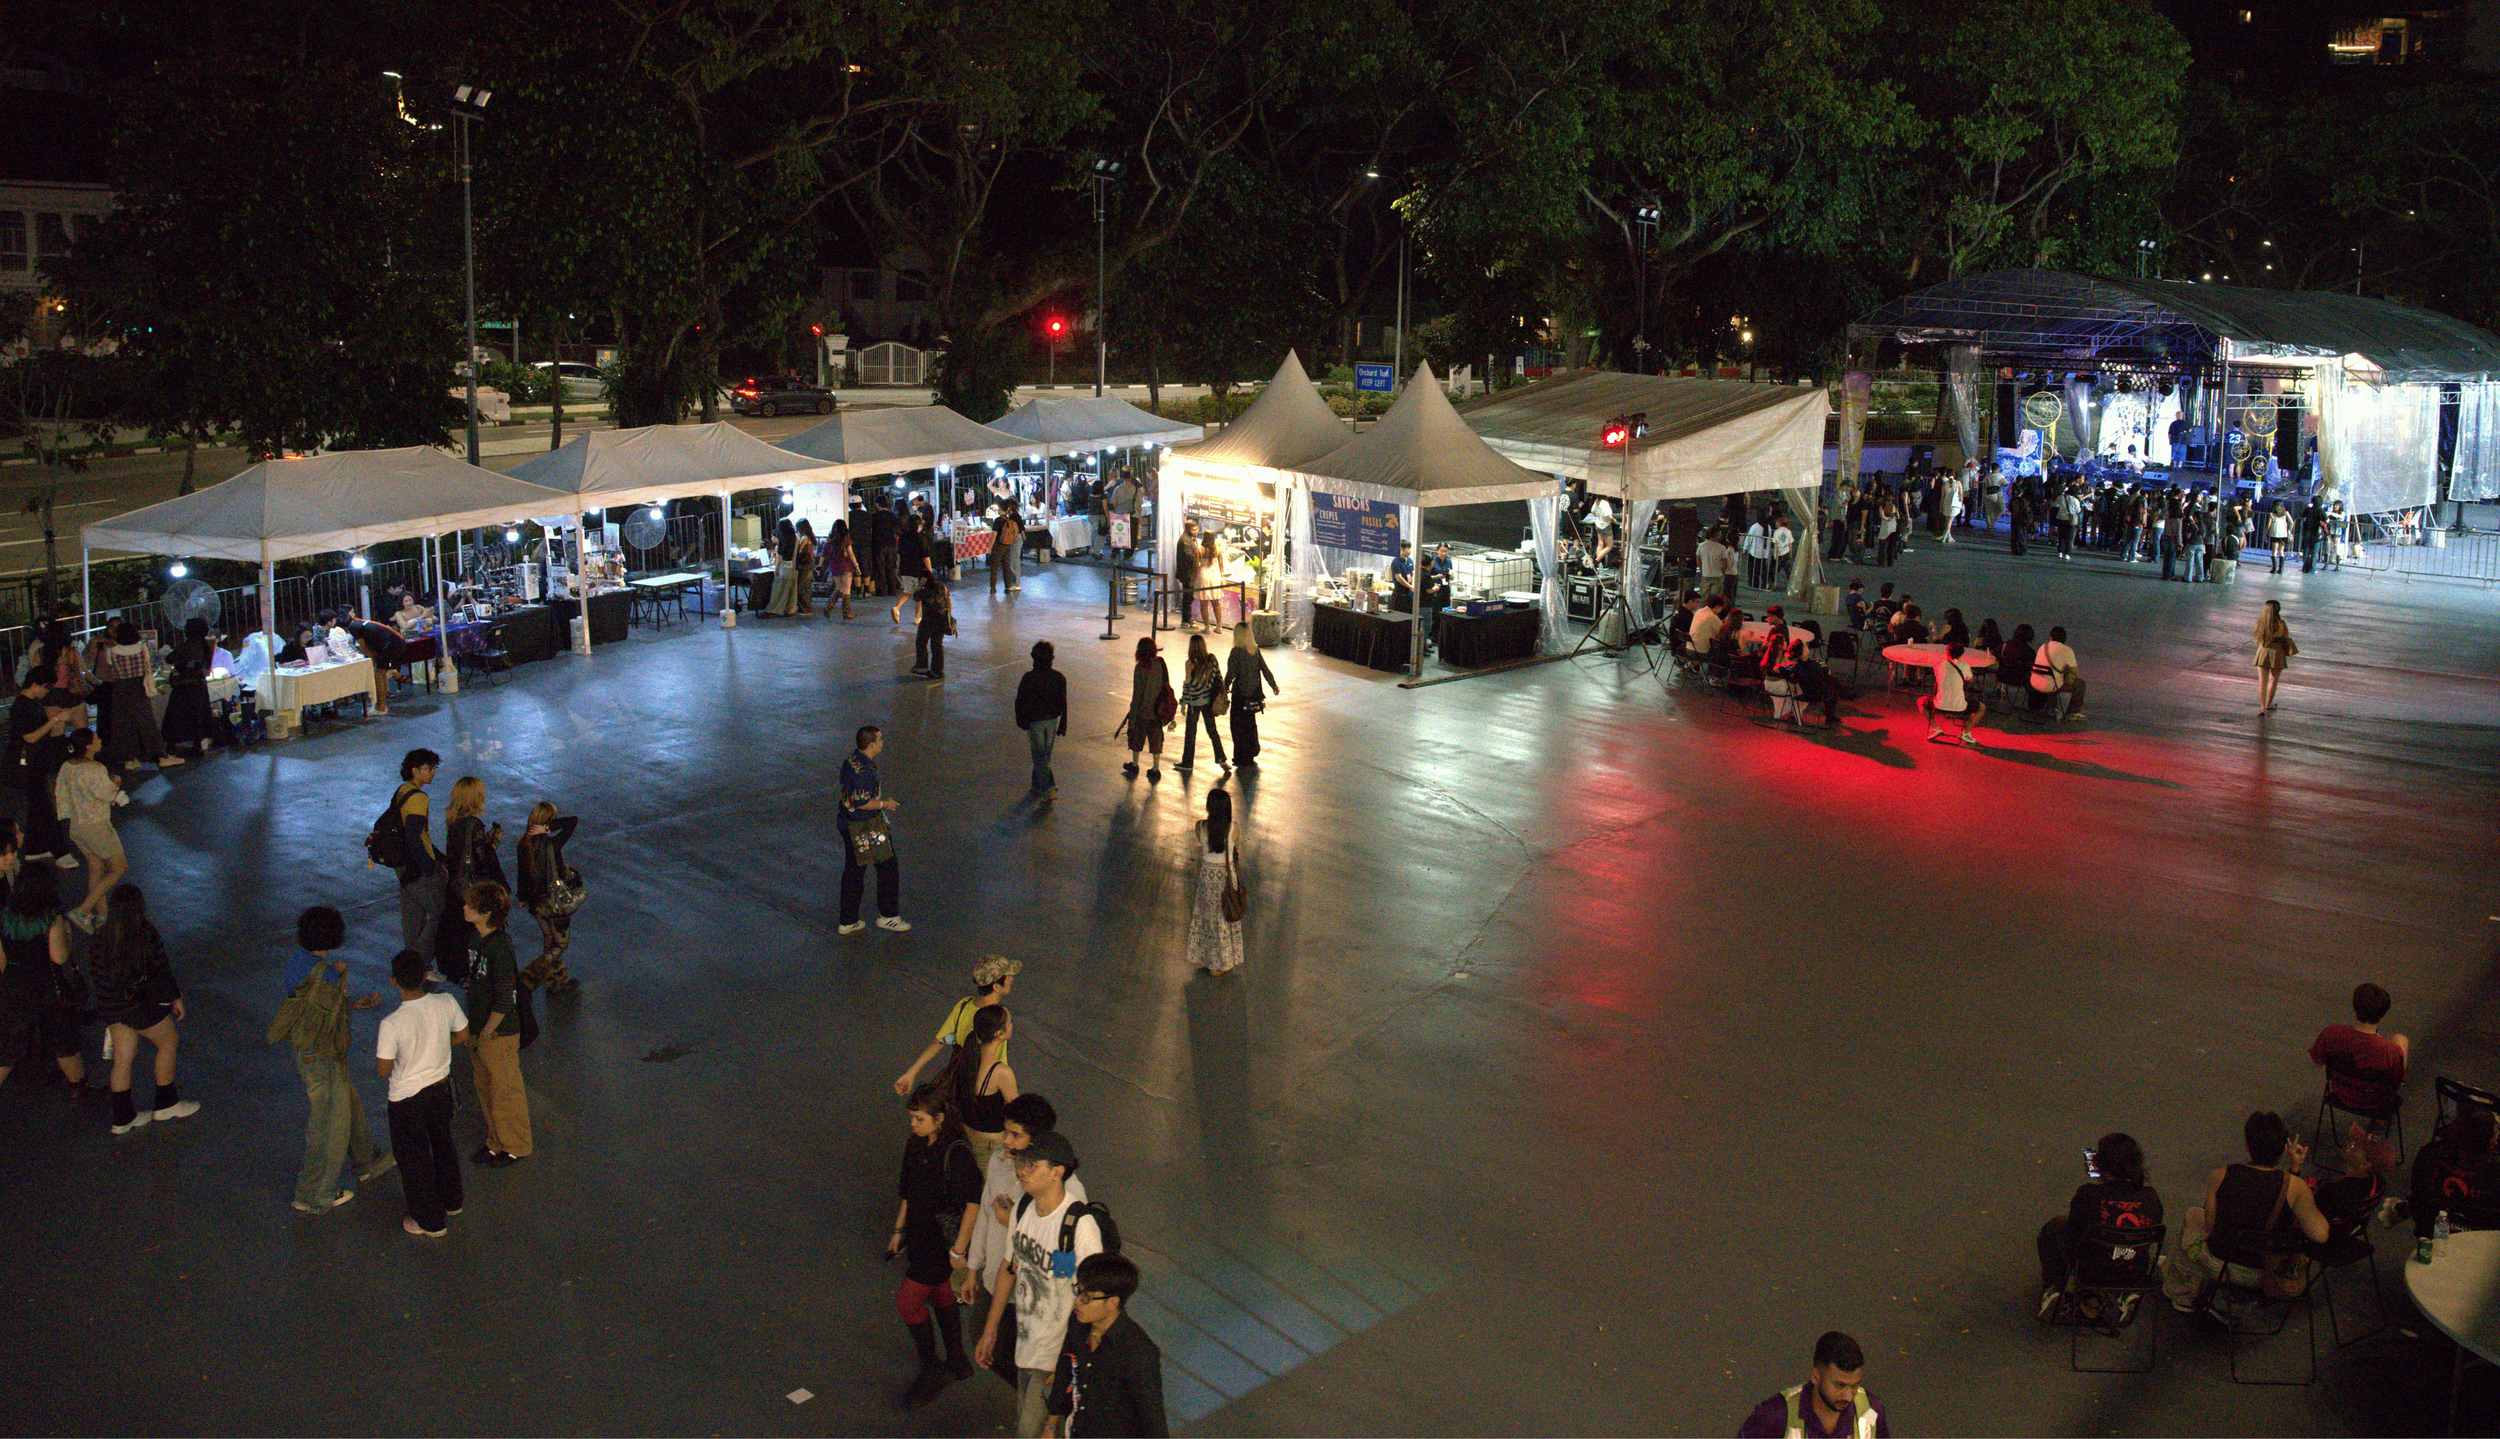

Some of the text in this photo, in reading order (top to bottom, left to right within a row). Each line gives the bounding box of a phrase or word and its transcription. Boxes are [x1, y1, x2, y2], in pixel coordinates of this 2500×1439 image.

[1359, 368, 1378, 377] Orchard
[1362, 378, 1386, 387] KEEP LEFT
[2229, 433, 2242, 444] 23
[1333, 495, 1370, 512] SAYBONS
[1319, 509, 1338, 521] CREPES
[1361, 515, 1383, 528] PASTAS
